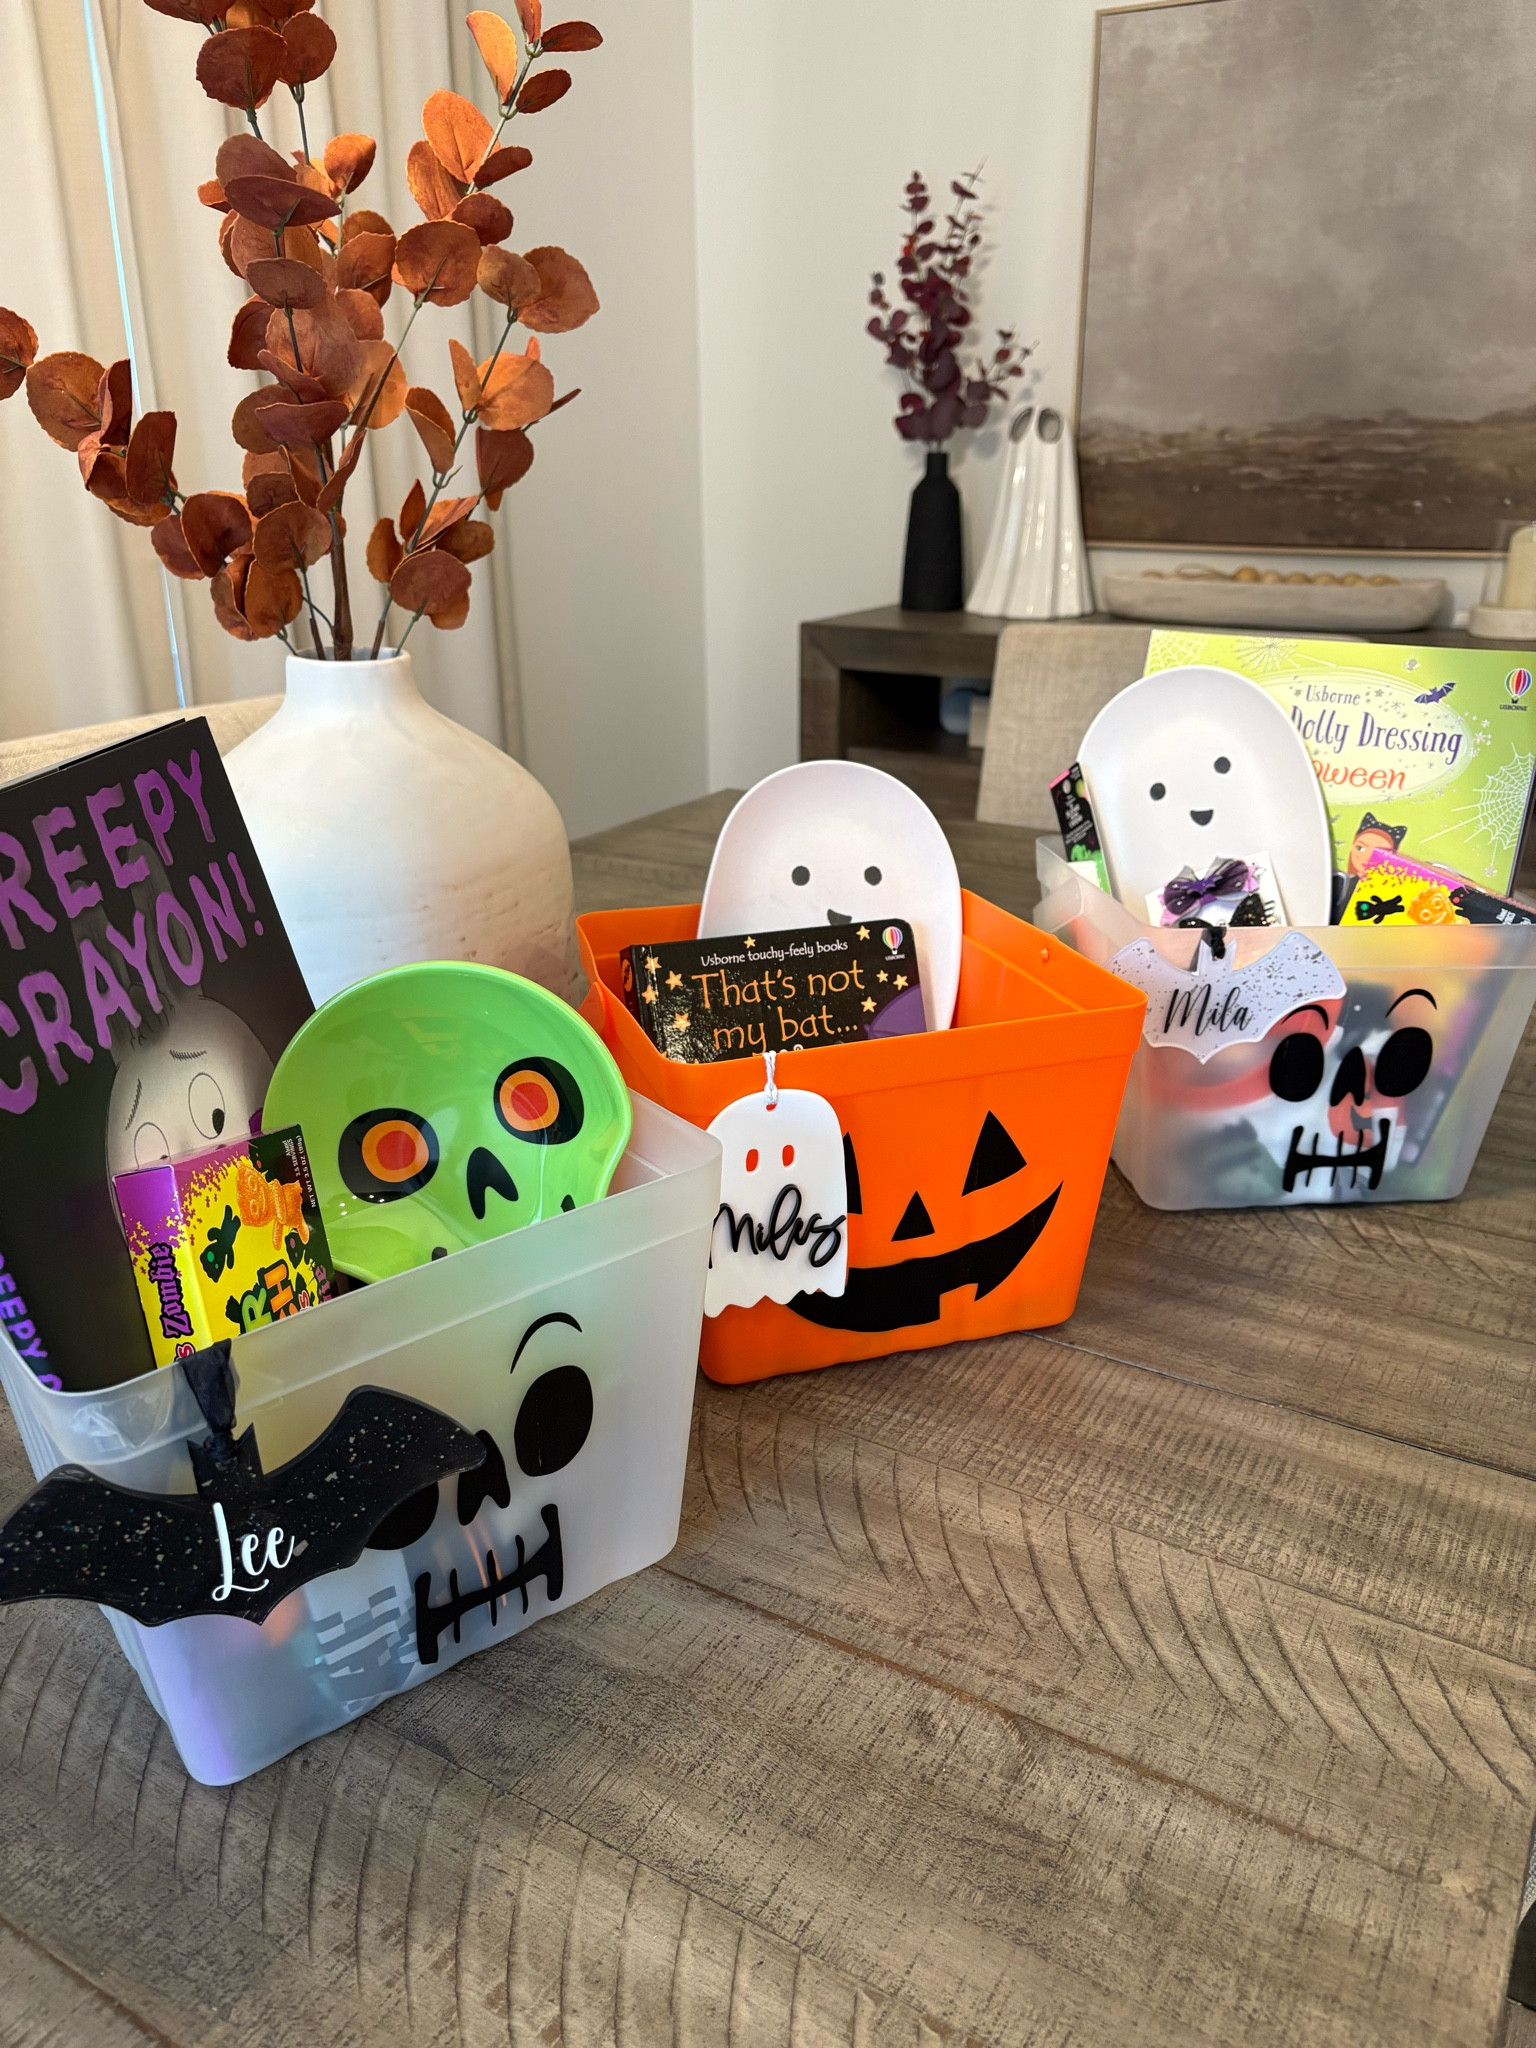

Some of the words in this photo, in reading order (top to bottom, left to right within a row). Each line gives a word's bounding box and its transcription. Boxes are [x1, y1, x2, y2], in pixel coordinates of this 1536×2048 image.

[1306, 684, 1361, 706] Usborne
[1291, 705, 1350, 754] Dolly
[1357, 711, 1464, 766] Dressing
[1312, 759, 1406, 791] oween
[0, 749, 216, 950] REEPY
[700, 953, 746, 967] Usborne
[747, 942, 814, 962] touchy-feely
[816, 939, 848, 954] books
[691, 968, 796, 1010] That's
[808, 959, 866, 997] not
[1163, 983, 1255, 1037] Mila
[713, 1021, 767, 1055] my
[777, 1005, 858, 1042] bat...
[0, 1252, 48, 1358] EEPY
[149, 1243, 194, 1338] Zombie
[211, 1501, 295, 1601] Lee
